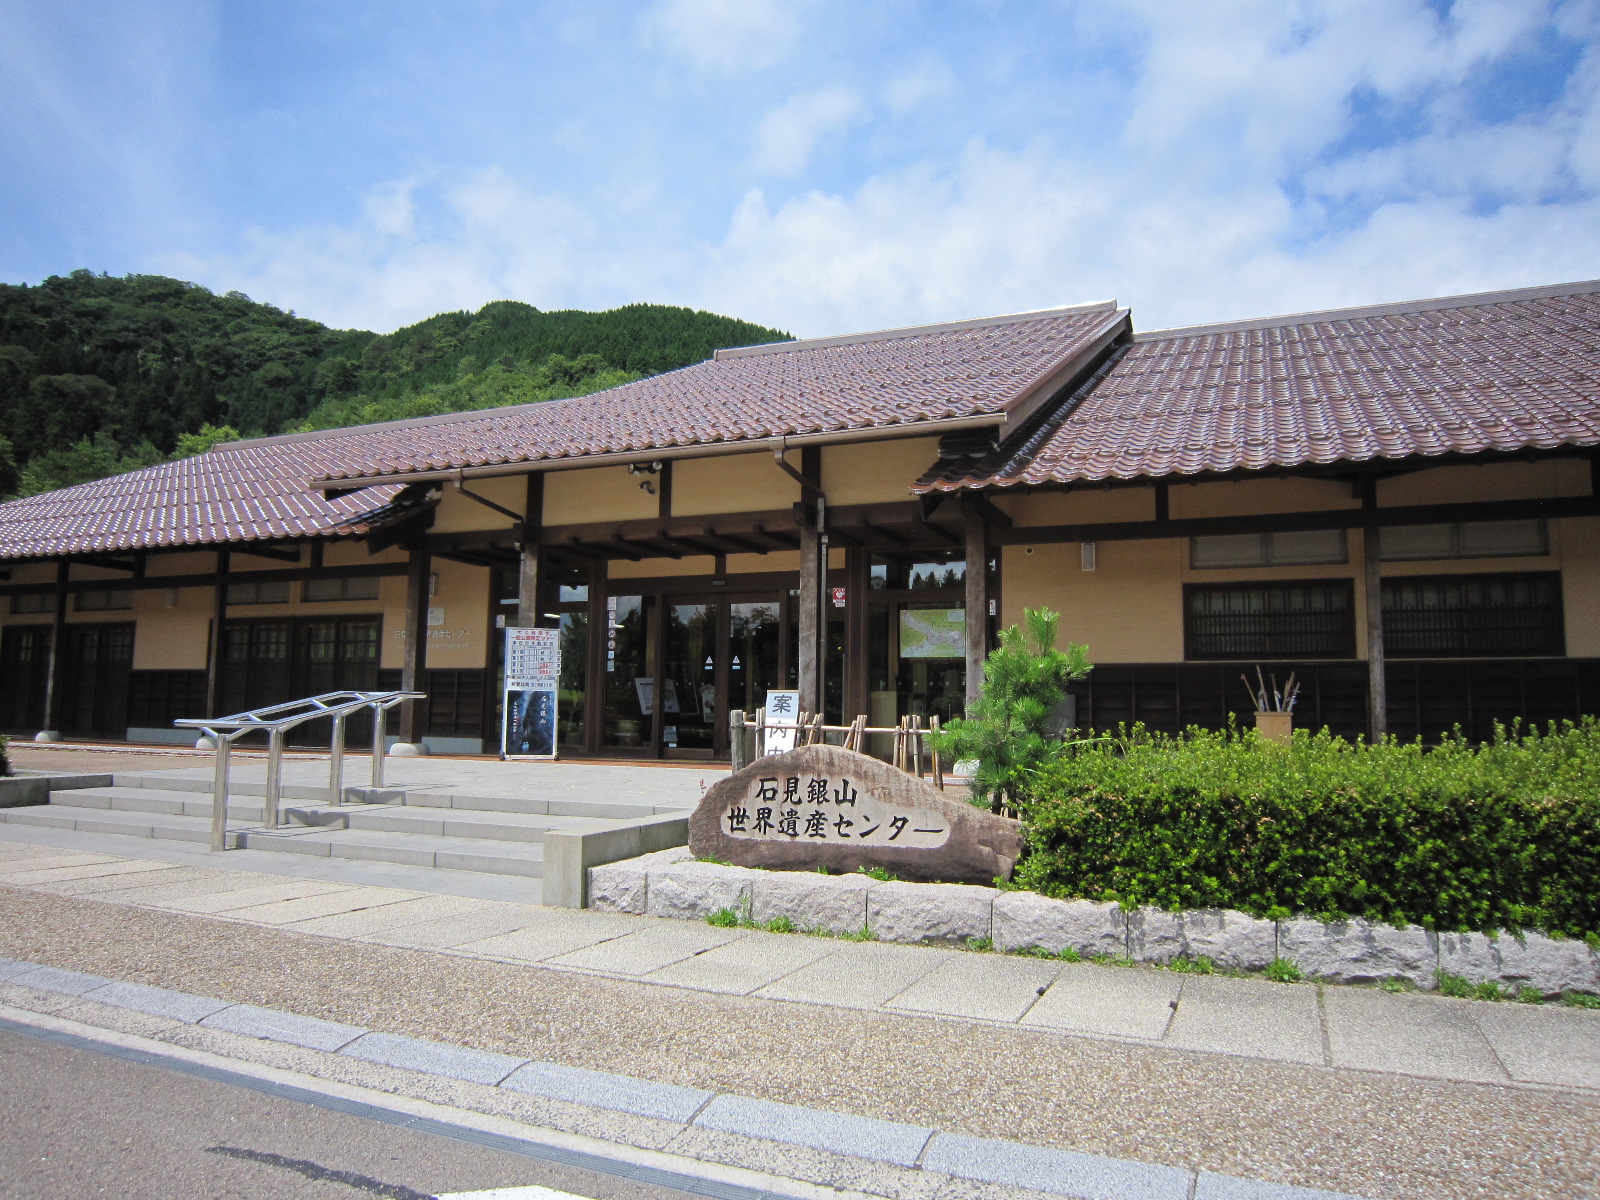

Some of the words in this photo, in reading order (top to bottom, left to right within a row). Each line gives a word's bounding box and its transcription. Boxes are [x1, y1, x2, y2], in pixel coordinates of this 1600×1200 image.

[755, 776, 857, 807] 石見銀山
[727, 807, 944, 840] 世界遺産センター
